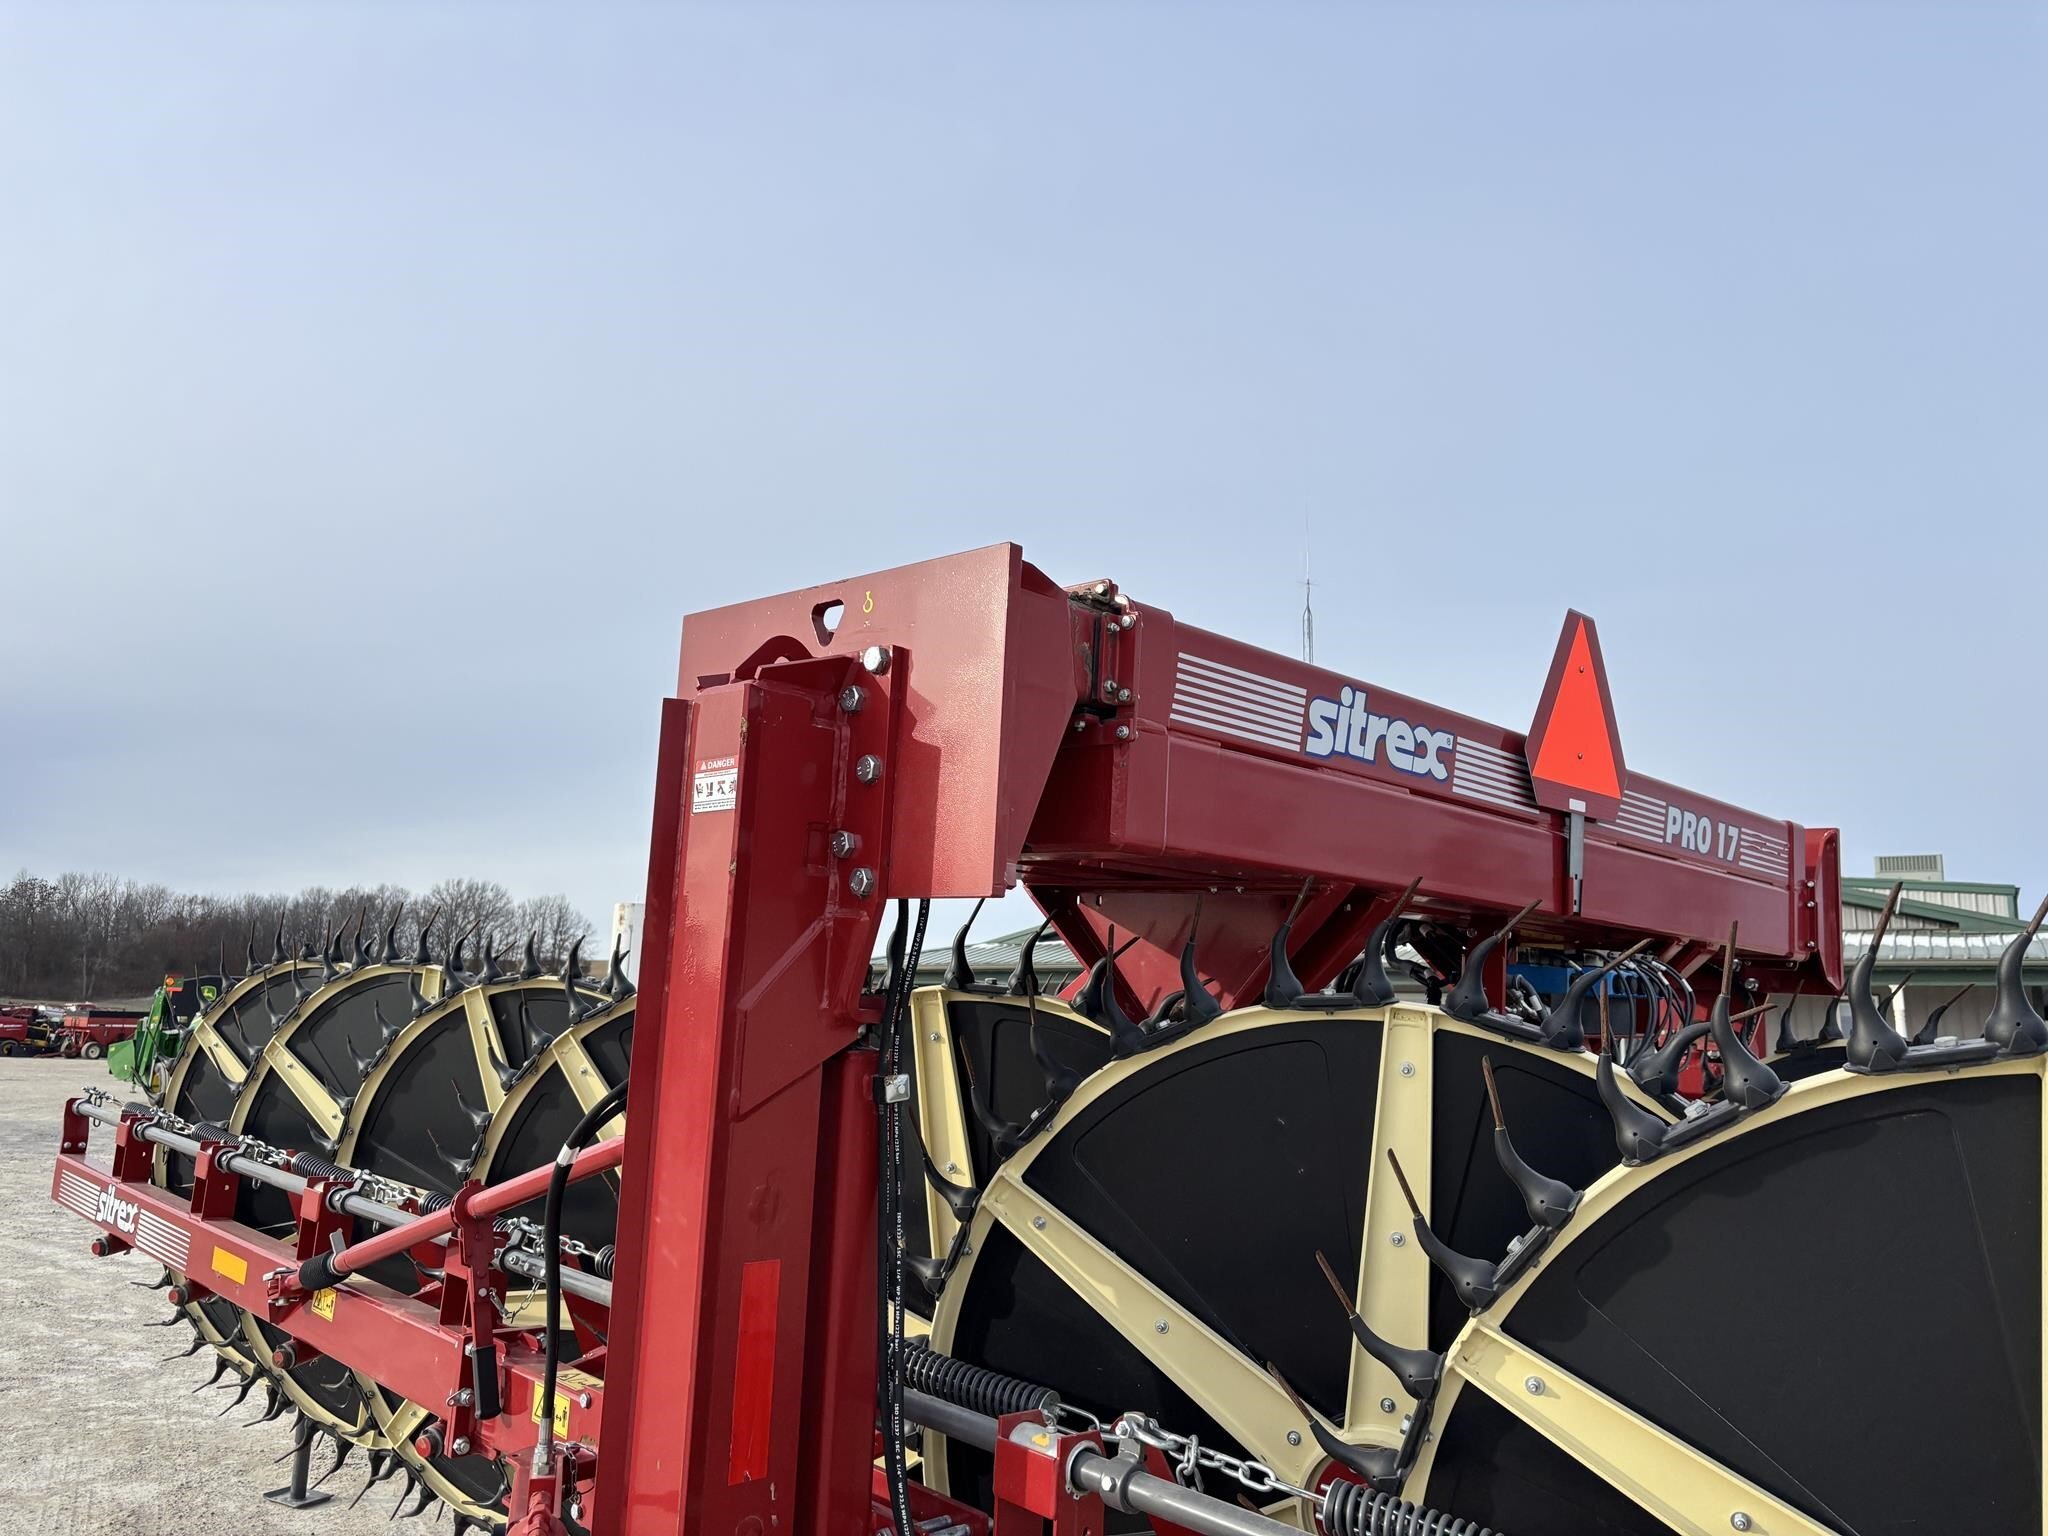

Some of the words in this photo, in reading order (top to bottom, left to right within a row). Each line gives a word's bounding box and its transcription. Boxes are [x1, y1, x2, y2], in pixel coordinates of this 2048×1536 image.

[707, 758, 735, 769] DANGER
[1665, 805, 1712, 855] PRO
[1717, 821, 1739, 861] 17
[96, 1183, 139, 1233] sitrex
